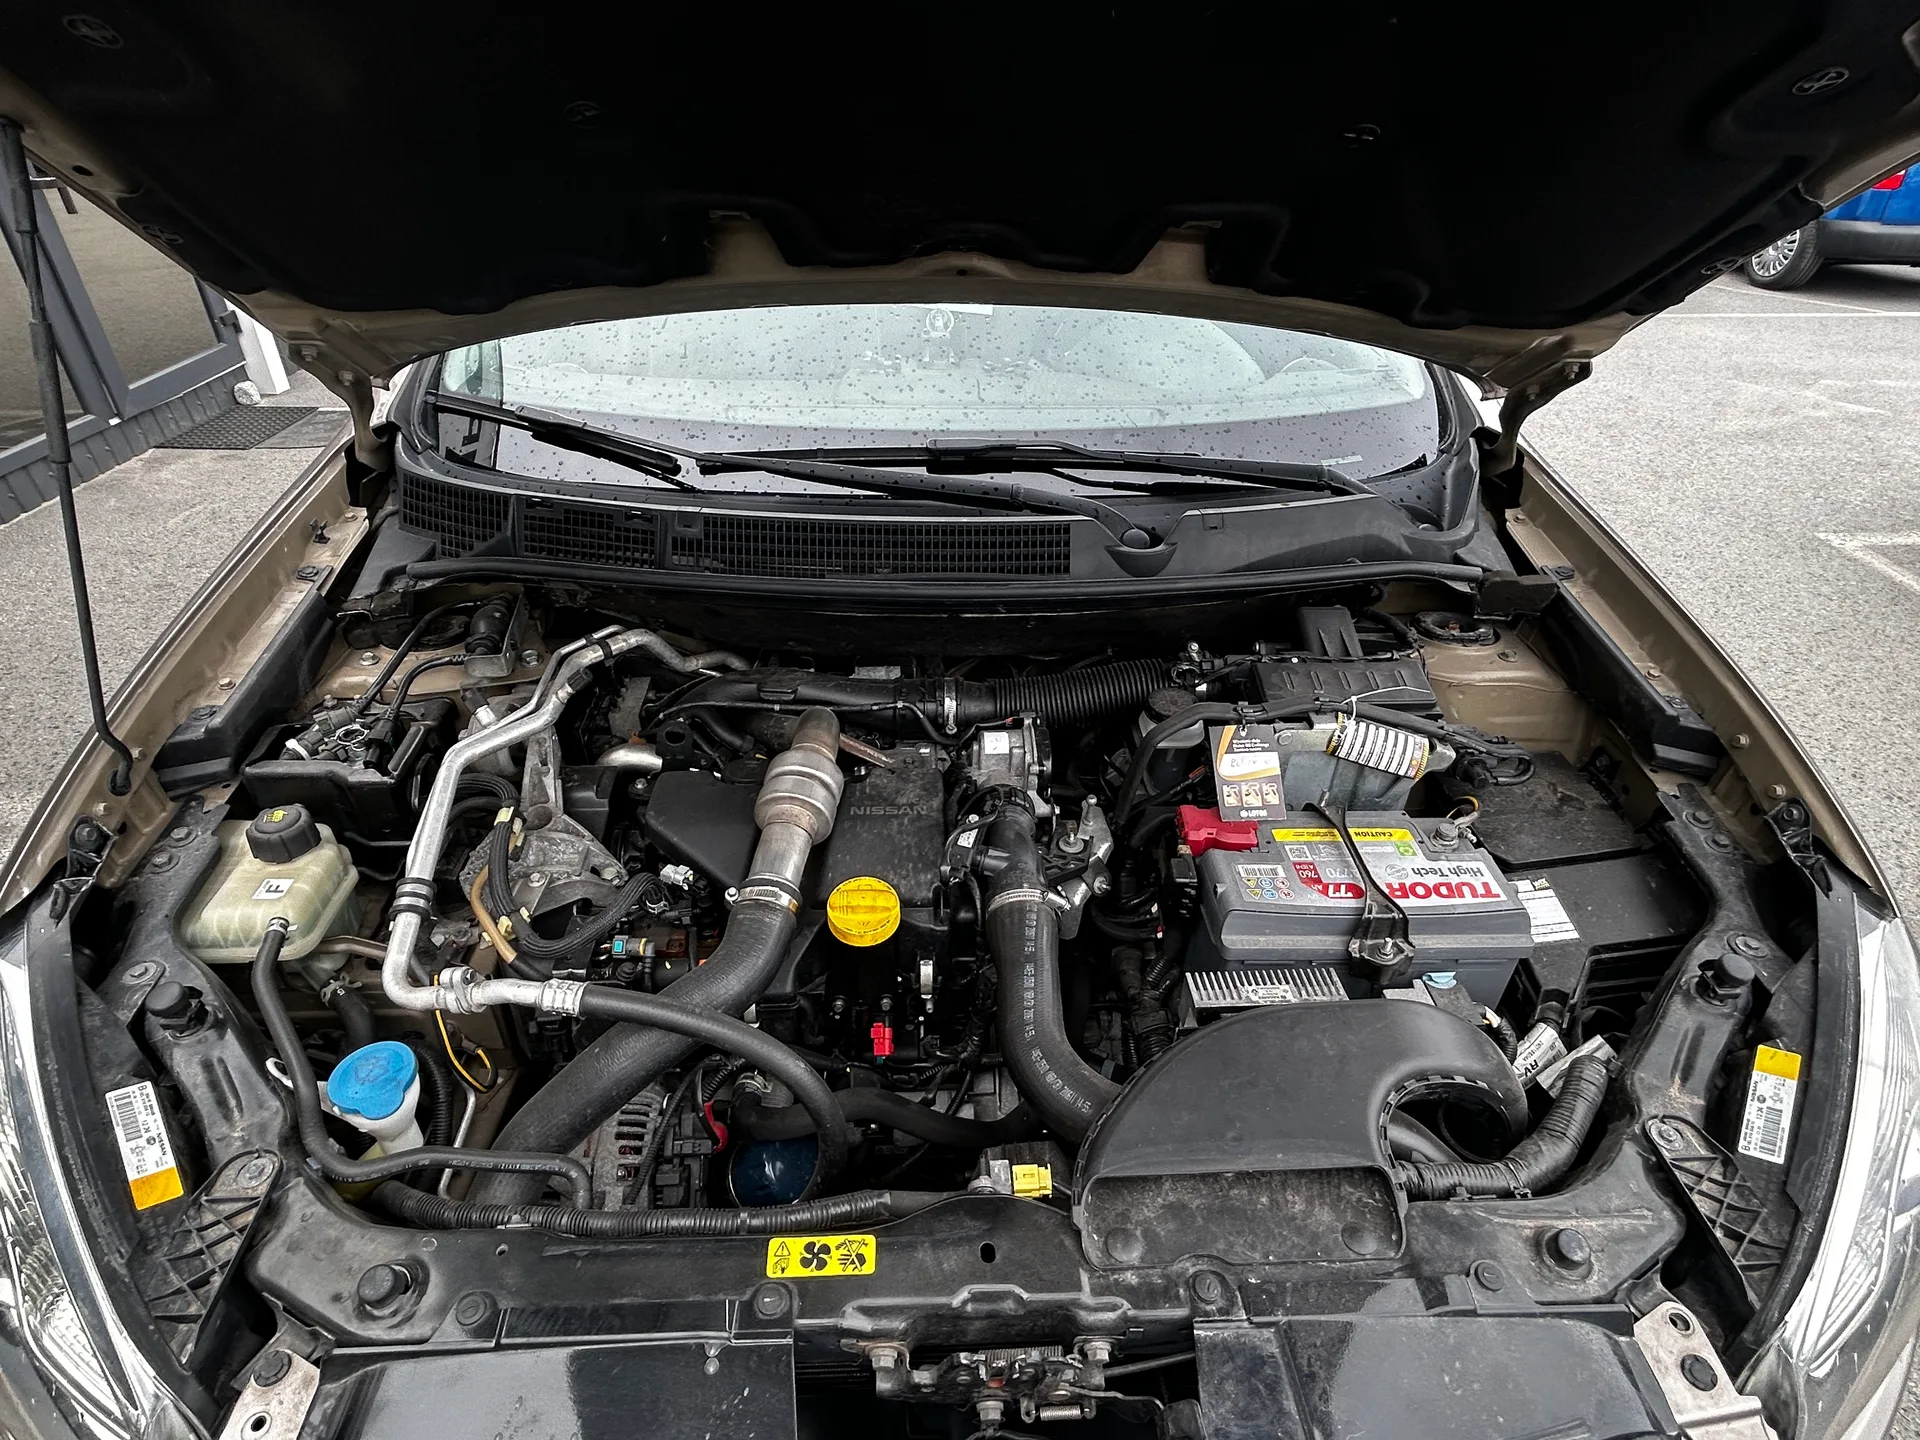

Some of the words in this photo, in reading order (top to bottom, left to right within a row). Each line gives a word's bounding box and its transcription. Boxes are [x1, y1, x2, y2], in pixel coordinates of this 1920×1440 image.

[850, 805, 927, 814] NISSAN
[1298, 869, 1317, 877] 760
[1411, 867, 1447, 876] Tech
[1447, 865, 1483, 877] High
[265, 884, 284, 893] F
[1327, 883, 1353, 897] 77
[1384, 881, 1500, 898] TUDOR
[1524, 1059, 1539, 1077] RV
